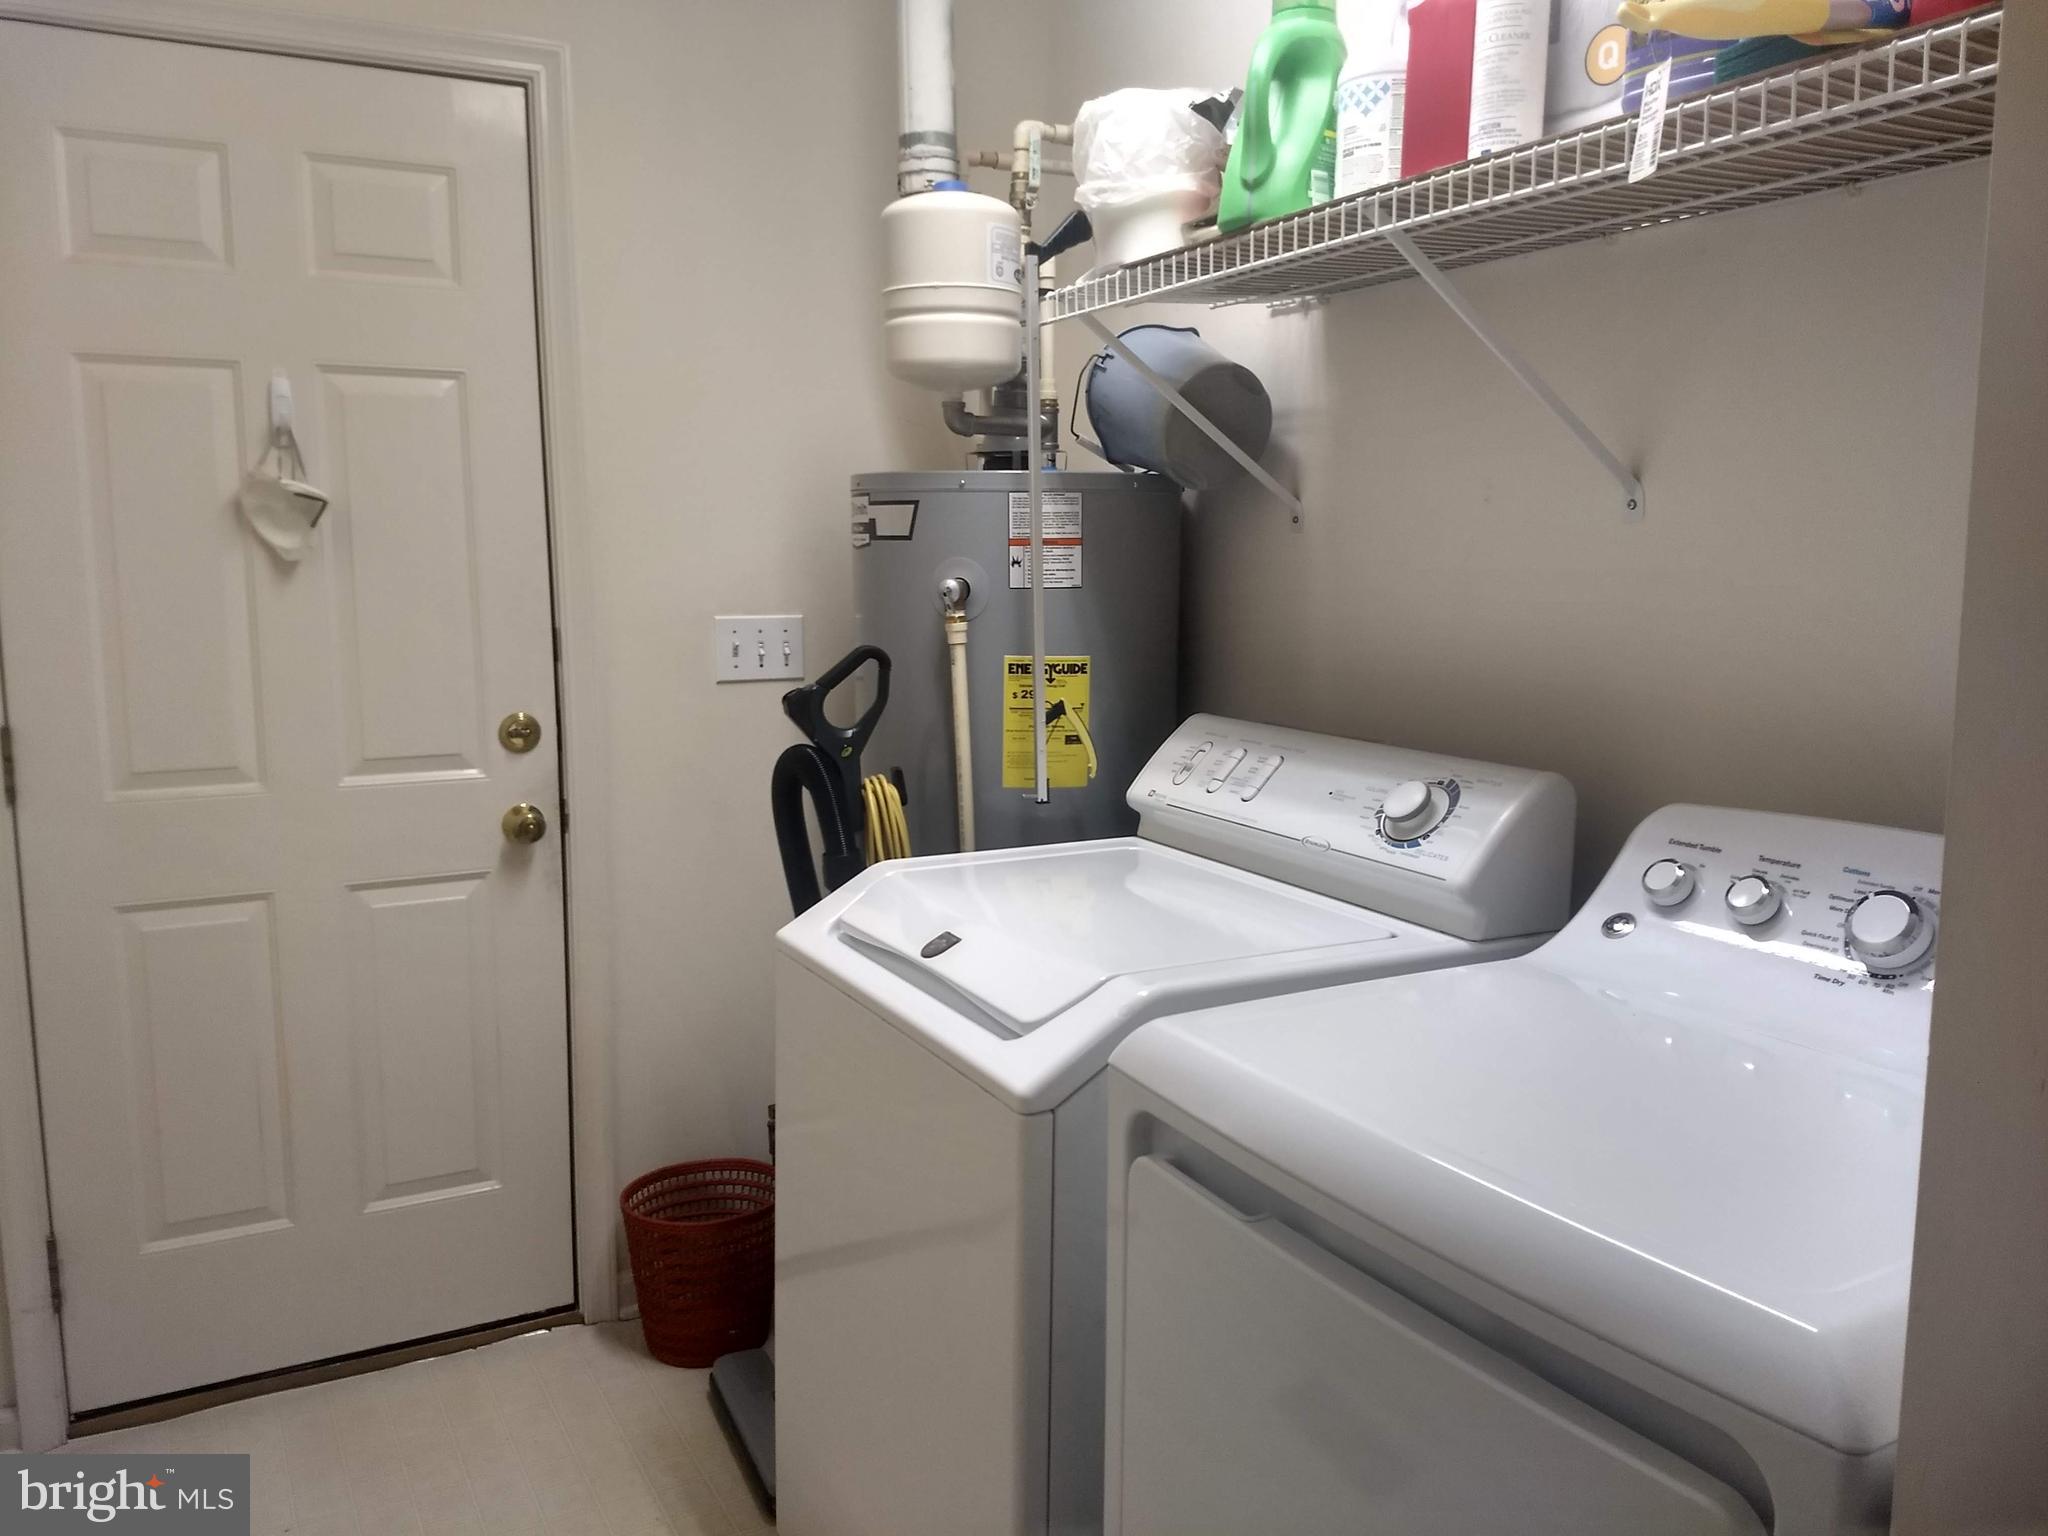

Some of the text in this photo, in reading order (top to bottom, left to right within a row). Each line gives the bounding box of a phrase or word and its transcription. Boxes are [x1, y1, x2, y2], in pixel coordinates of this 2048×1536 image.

[1597, 40, 1619, 70] Q
[1008, 663, 1088, 675] ENEYGUIDE
[1668, 838, 1722, 854] Extended Tumble
[1758, 855, 1802, 869] Temperature
[1843, 866, 1871, 877] Cottons
[1814, 973, 1845, 987] Time Dry
